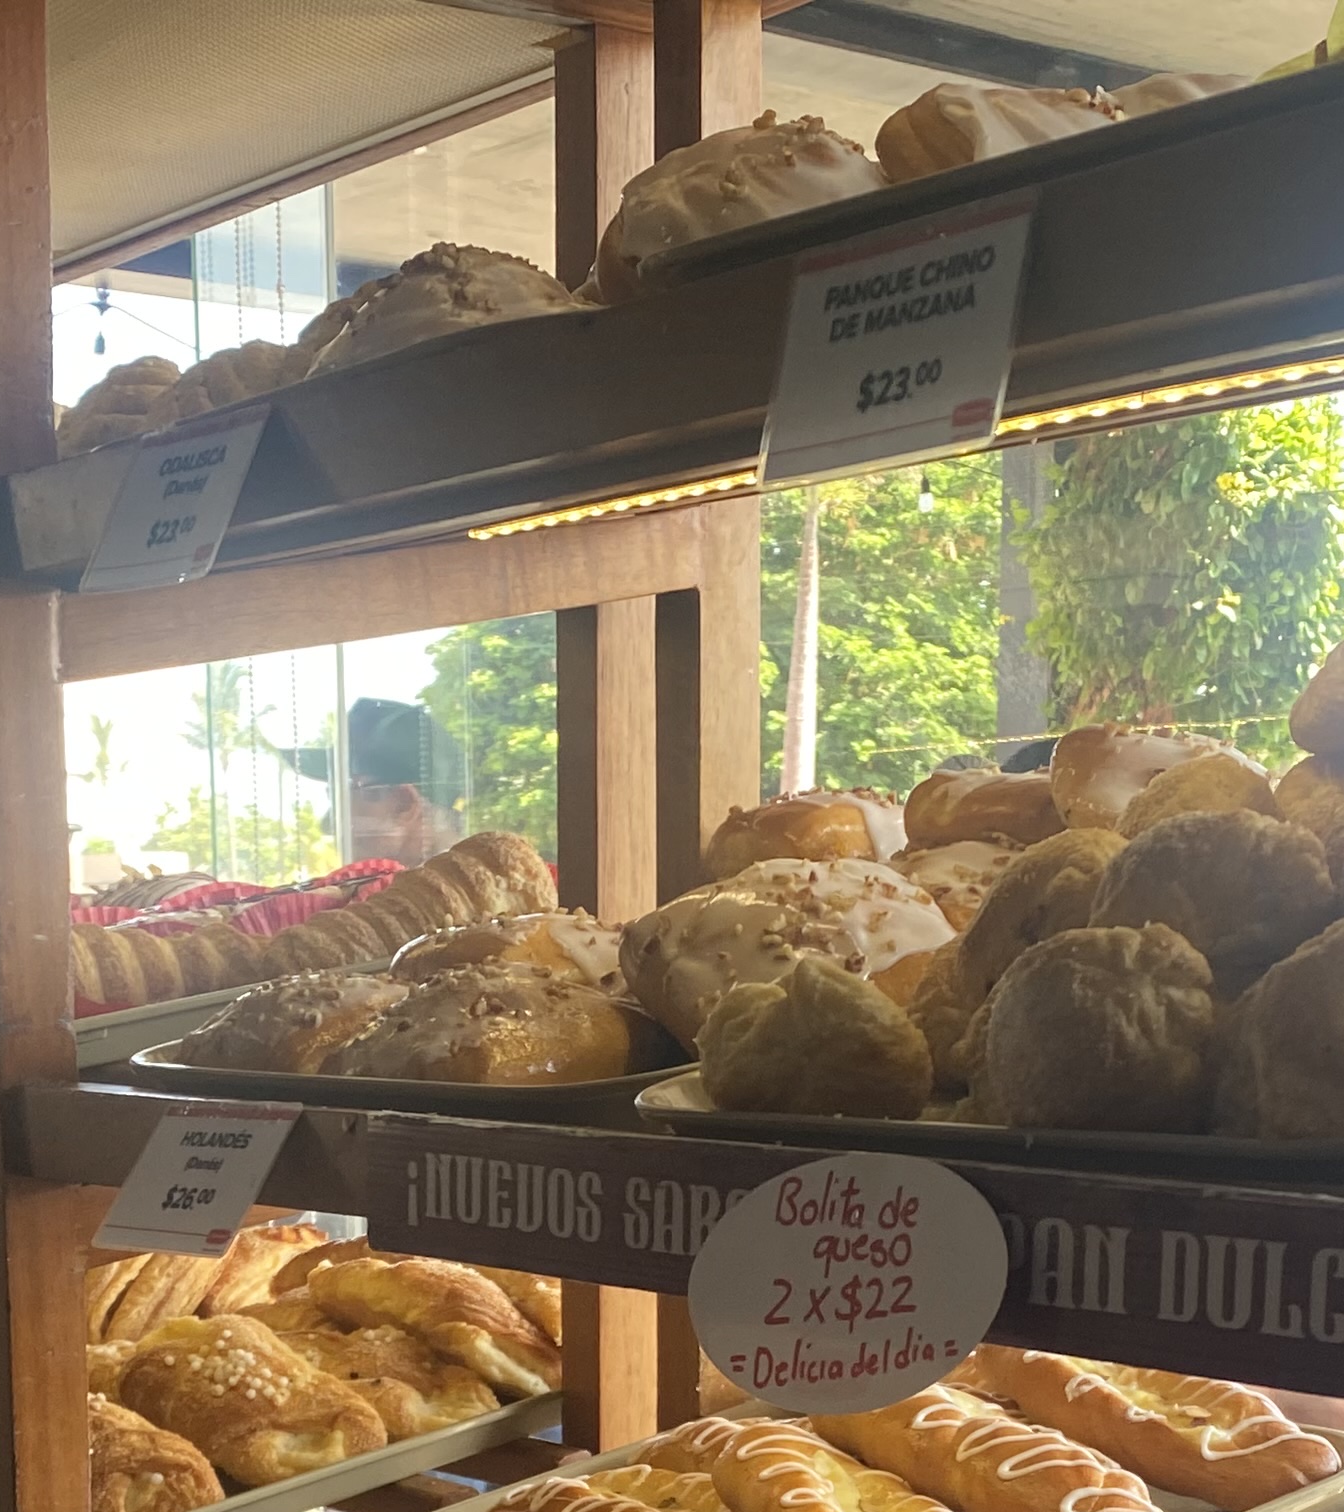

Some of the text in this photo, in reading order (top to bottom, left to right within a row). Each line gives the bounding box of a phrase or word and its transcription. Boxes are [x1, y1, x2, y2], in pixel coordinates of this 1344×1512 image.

[919, 245, 996, 286] CHINO
[829, 284, 977, 343] DE MANZANA
[179, 1128, 254, 1150] HOLANDÉS
[623, 1166, 756, 1256] SAB
[775, 1170, 921, 1230] Bolita de
[813, 1233, 913, 1279] queso
